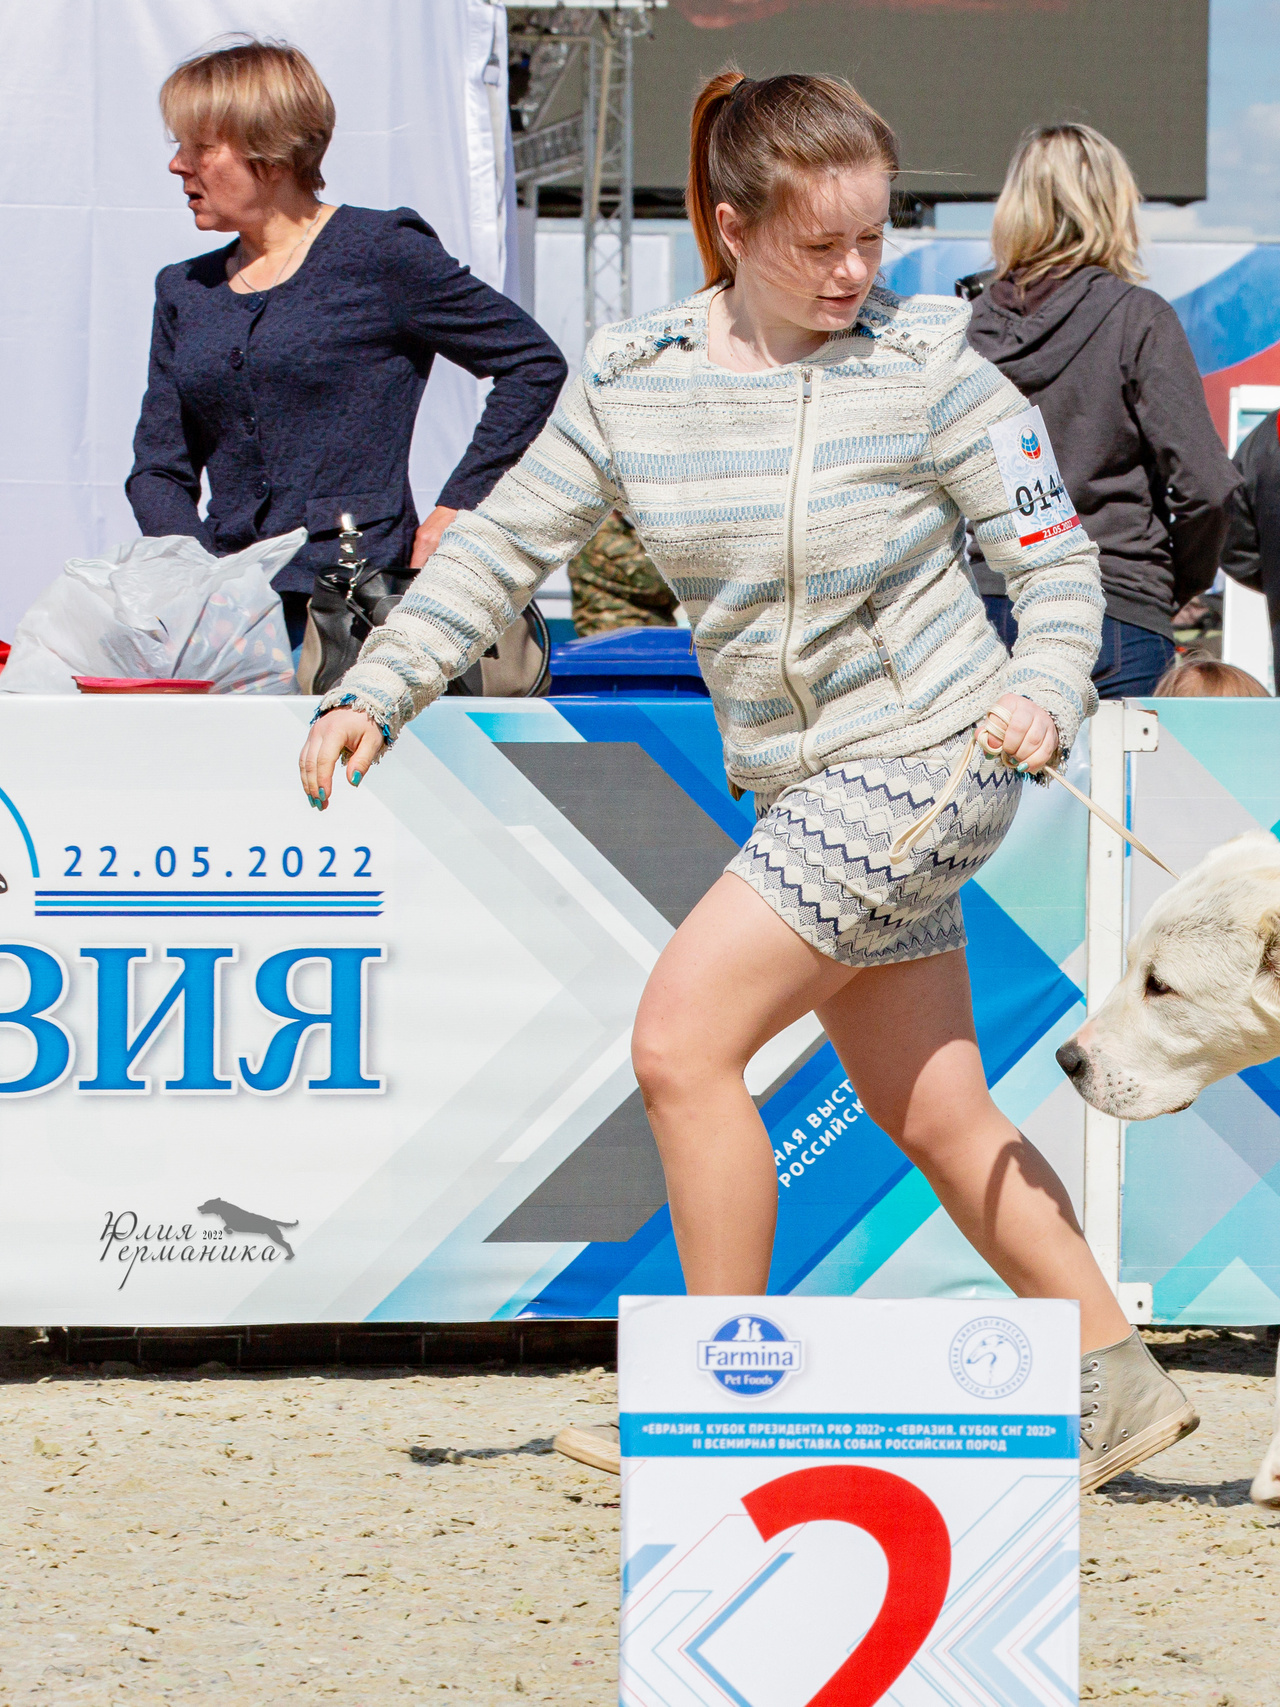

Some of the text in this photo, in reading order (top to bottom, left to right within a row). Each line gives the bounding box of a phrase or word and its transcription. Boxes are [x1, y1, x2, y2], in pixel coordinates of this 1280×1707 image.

[63, 845, 373, 878] 22.05.2022
[705, 1345, 793, 1366] Farmina
[724, 1374, 774, 1386] Pet Foods
[642, 1423, 704, 1435] «ЕВРАЗИЯ.
[706, 1424, 746, 1435] КУБОК
[748, 1424, 825, 1436] ПРЕЗИДЕНТА
[827, 1424, 853, 1435] РКФ
[959, 1425, 998, 1436] КУБОК
[1001, 1425, 1023, 1436] СНГ
[704, 1438, 775, 1449] ВСЕМИРНАЯ
[779, 1438, 841, 1449] ВЫСТАВКА
[843, 1438, 882, 1449] СОБАК
[885, 1437, 963, 1450] РОССИЙСКИХ
[966, 1439, 1007, 1452] ПОРОД
[740, 1464, 952, 1707] 2
